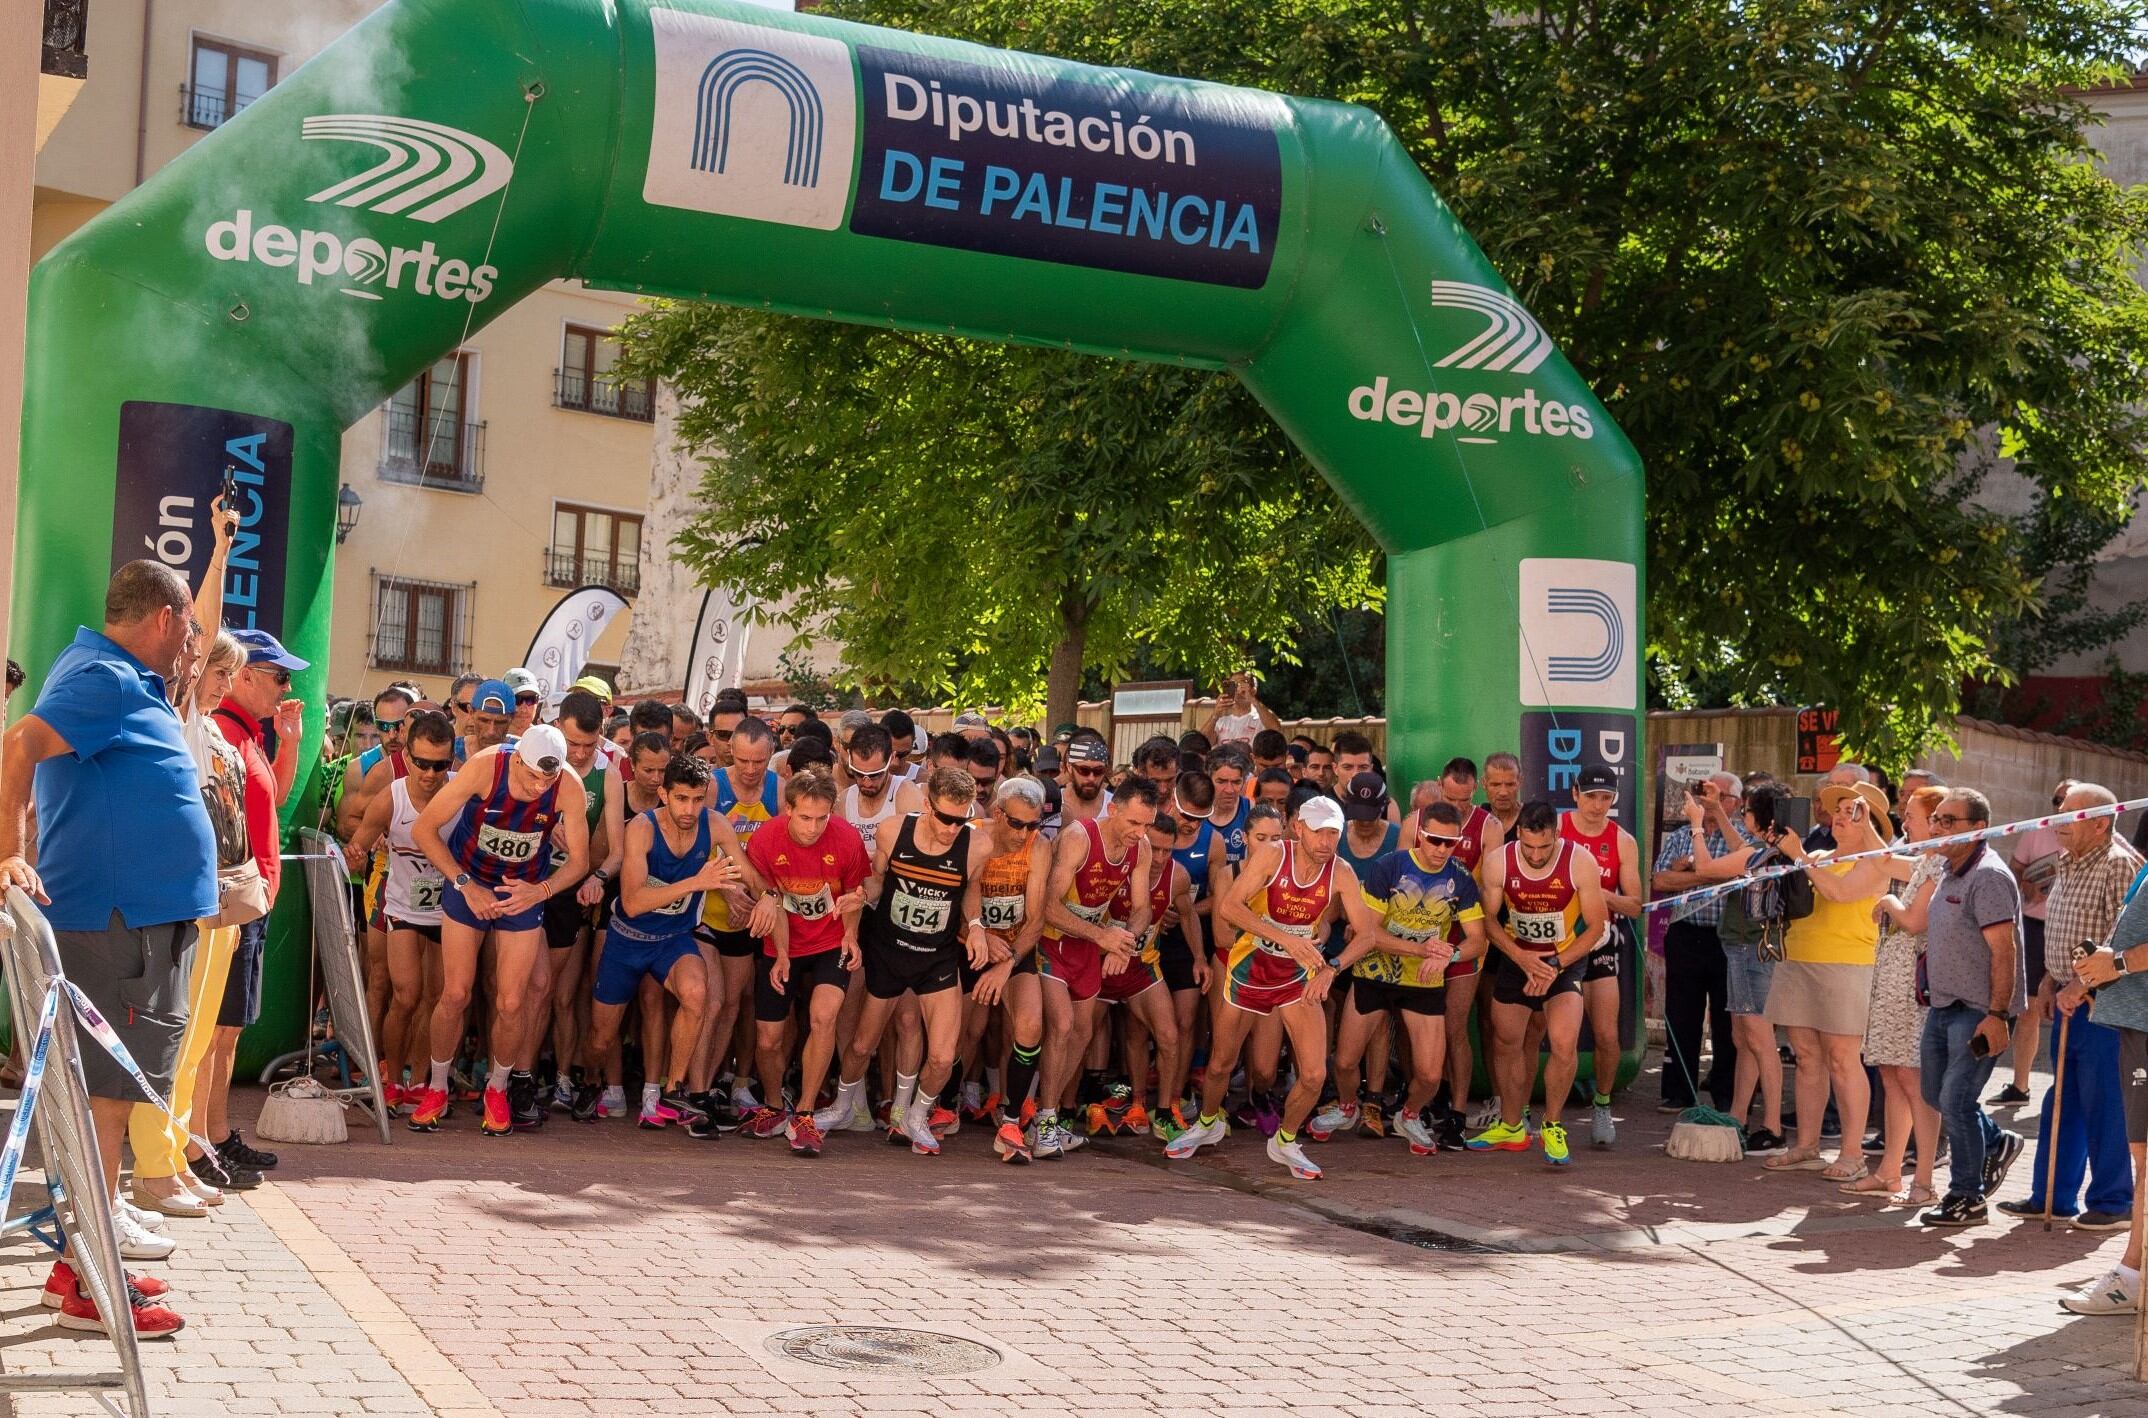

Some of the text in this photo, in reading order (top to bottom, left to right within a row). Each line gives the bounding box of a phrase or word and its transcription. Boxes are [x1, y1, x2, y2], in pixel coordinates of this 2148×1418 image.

[883, 72, 1196, 167] Diputación
[879, 149, 1261, 254] DE PALENCIA
[205, 209, 498, 303] deportes
[1348, 376, 1594, 440] deportes
[1799, 711, 1818, 732] SE
[485, 837, 531, 858] 480
[917, 886, 949, 898] VICKY
[898, 904, 940, 929] 154
[1516, 919, 1557, 938] 538
